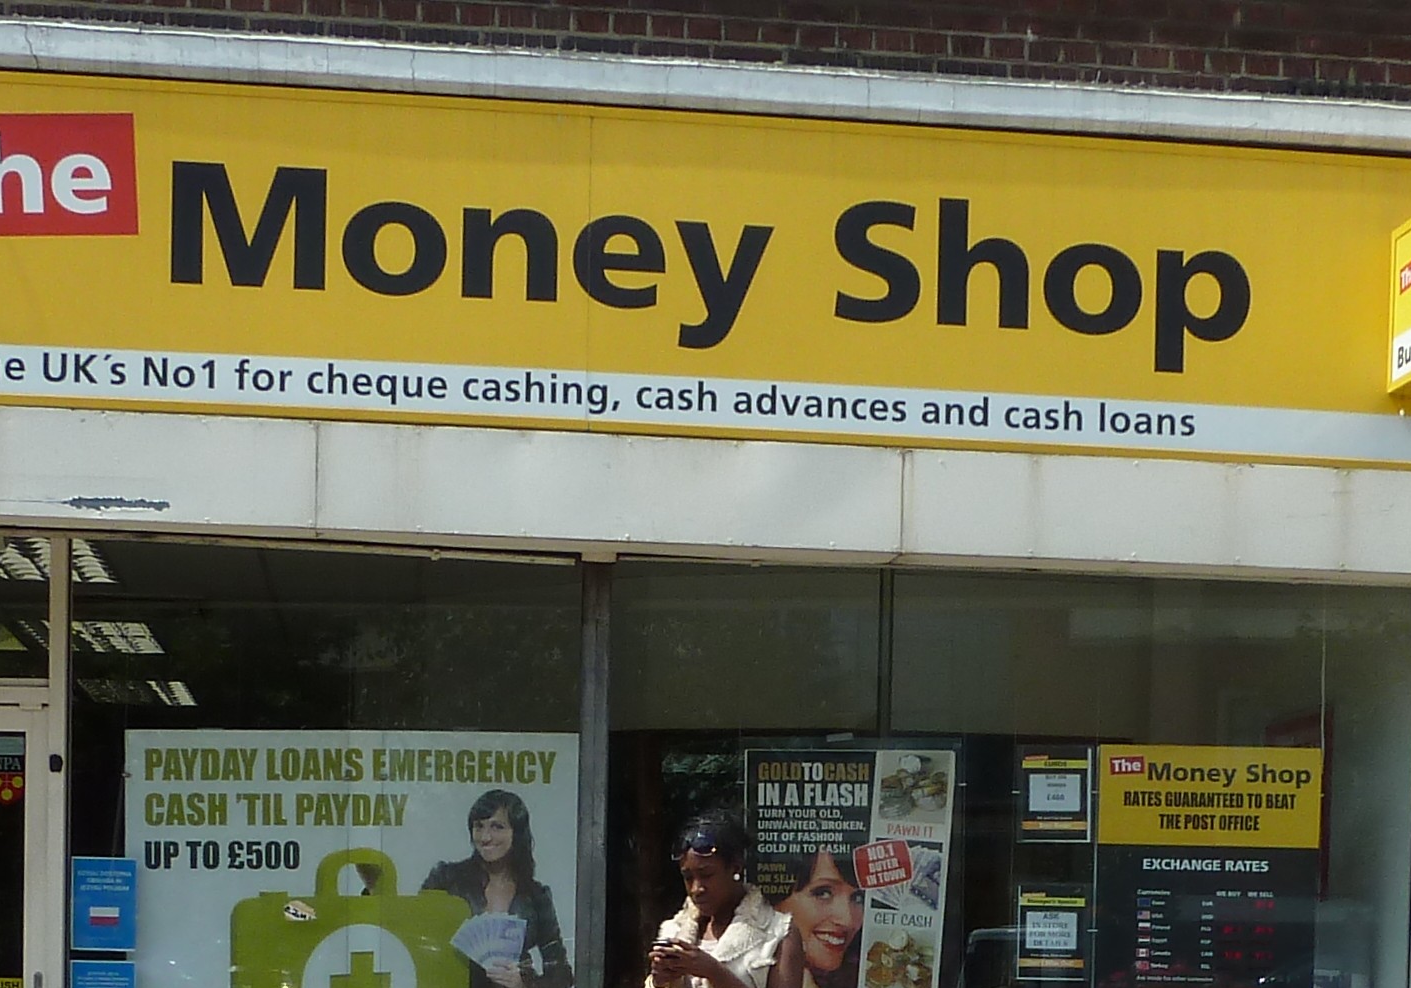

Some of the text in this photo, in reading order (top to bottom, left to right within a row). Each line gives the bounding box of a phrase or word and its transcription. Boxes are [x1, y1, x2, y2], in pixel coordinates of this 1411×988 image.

[170, 160, 1251, 373] Money Shop
[142, 356, 218, 390] No1
[234, 359, 292, 393] for
[306, 361, 448, 404] cheque
[462, 371, 621, 414] cashing,
[635, 379, 718, 413] cash
[732, 384, 907, 424] advances
[920, 395, 990, 428] and
[1003, 397, 1084, 432] cash
[1098, 403, 1197, 438] loans
[145, 748, 556, 784] PAYDAY LOANS EMERGENCY
[1111, 758, 1142, 773] The
[1148, 763, 1312, 788] Money Shop
[758, 783, 869, 807] IN A FLASH
[1124, 791, 1296, 810] RATES GUARANTEED TO BEAT
[145, 792, 408, 827] CASH 'TIL PAYDAY
[758, 809, 785, 818] TURN
[789, 809, 817, 819] YOUR
[758, 820, 866, 832] UNWANTED, BROKEN,
[1159, 814, 1260, 831] THE POST OFFICE
[758, 832, 843, 842] OUT OF FASHION
[887, 825, 934, 837] PAWN IT
[145, 841, 300, 870] UP TO £500
[758, 844, 850, 853] GOLD IN TO CASH!
[757, 863, 786, 872] PAWN
[1143, 858, 1269, 872] EXCHANGE RATES
[773, 874, 796, 883] SELL
[874, 912, 933, 928] GET CASH
